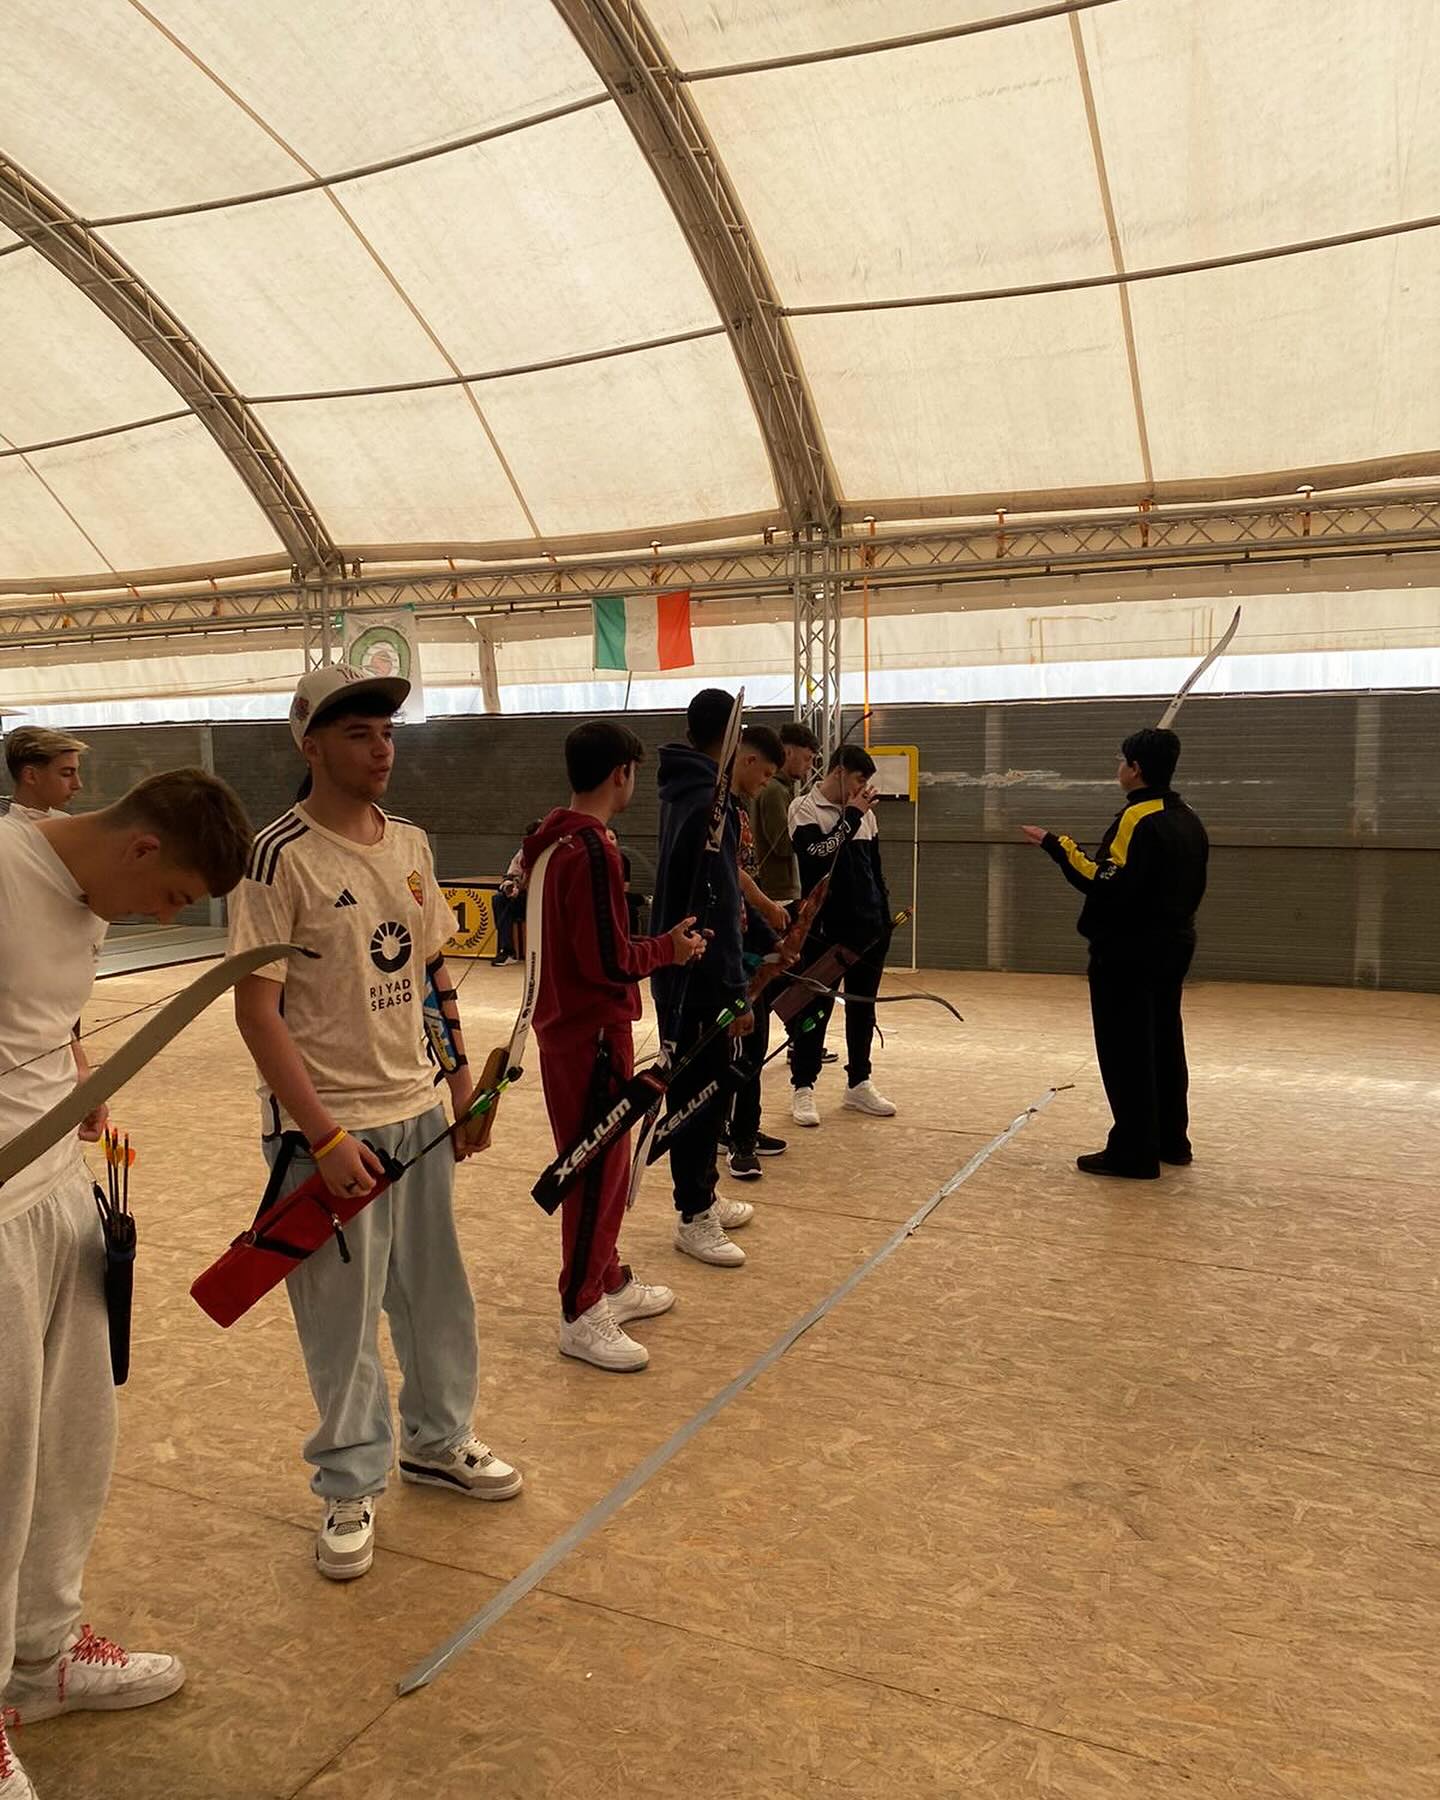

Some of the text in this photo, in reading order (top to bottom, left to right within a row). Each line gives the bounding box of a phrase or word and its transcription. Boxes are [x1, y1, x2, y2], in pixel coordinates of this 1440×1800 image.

[452, 901, 471, 933] 1
[369, 978, 411, 998] RIYAD
[370, 991, 412, 1012] SEASO
[654, 1079, 720, 1143] XELIUM
[553, 1097, 633, 1187] XELIUM
